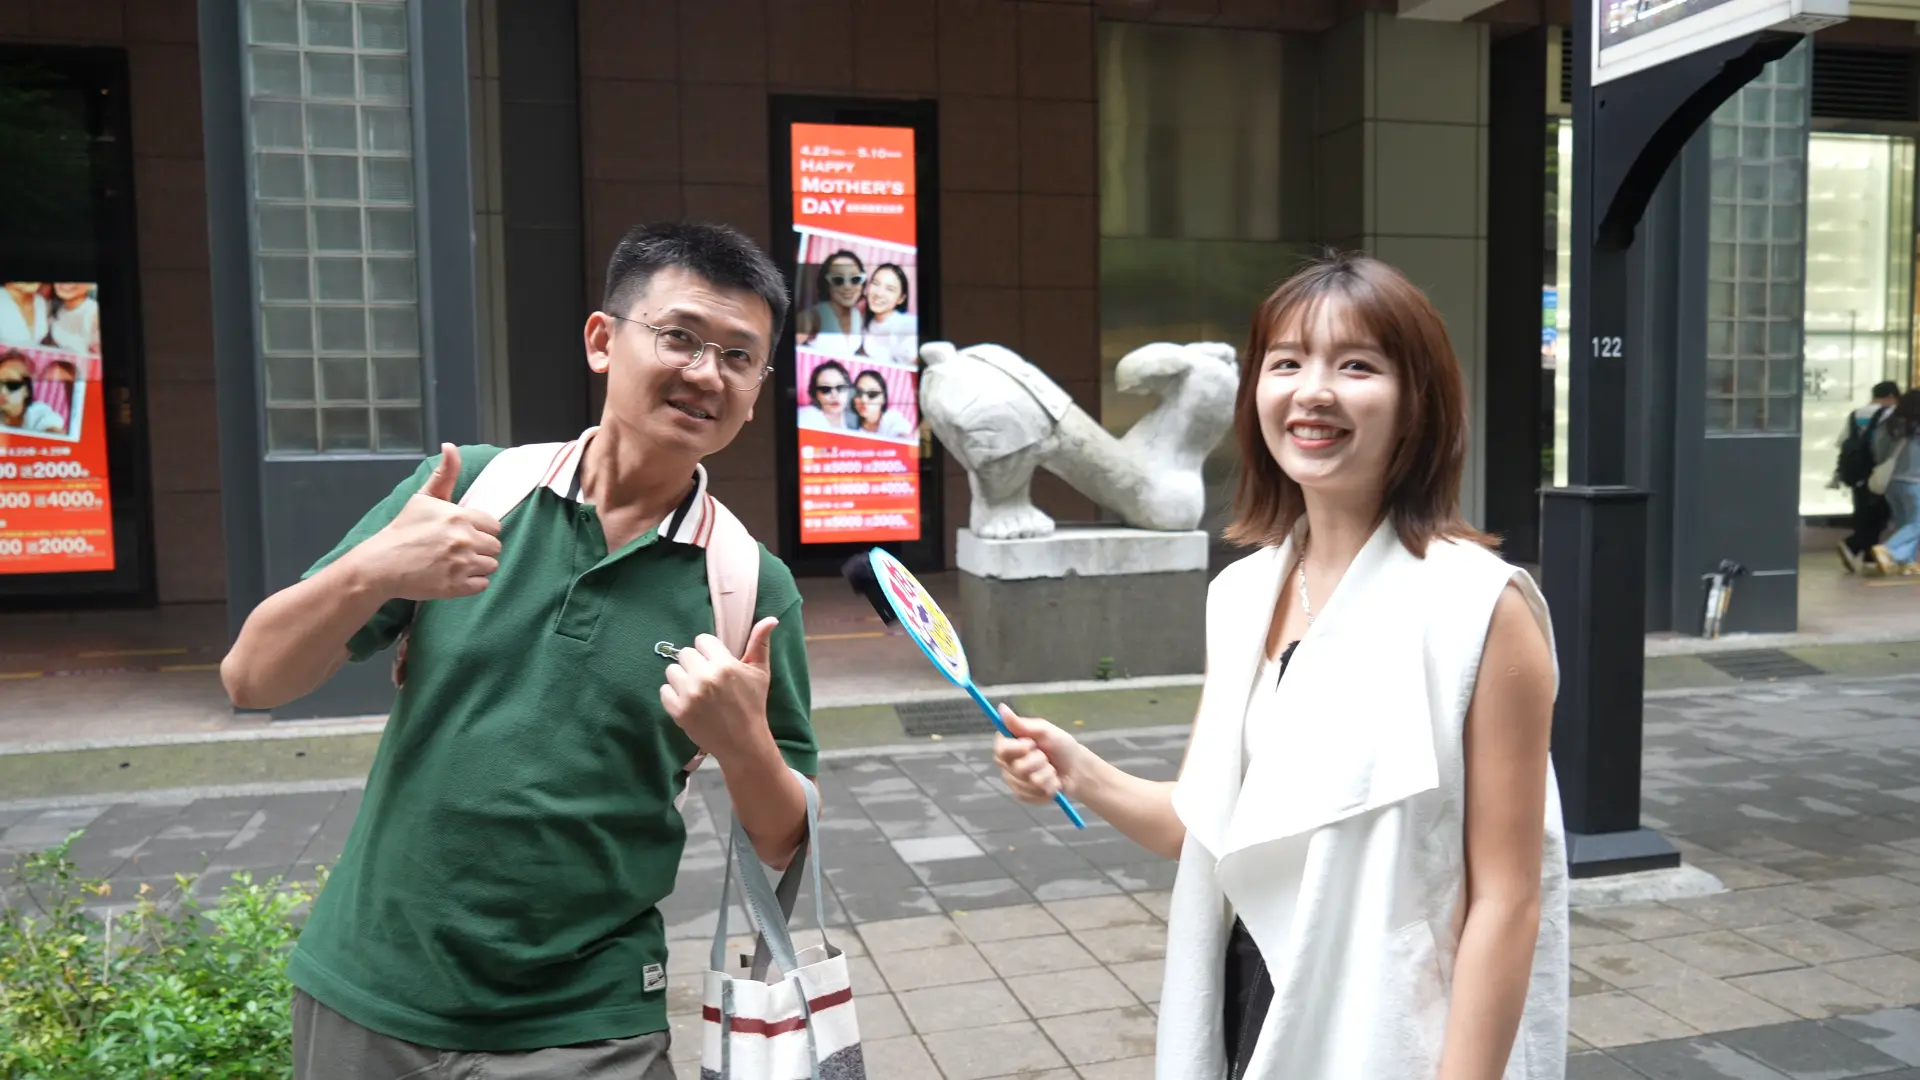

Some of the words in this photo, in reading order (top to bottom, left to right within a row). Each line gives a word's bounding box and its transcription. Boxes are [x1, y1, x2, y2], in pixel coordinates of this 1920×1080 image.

[800, 158, 855, 173] HAPPY
[801, 176, 904, 196] MOTHER'S
[801, 197, 845, 214] DAY
[1592, 336, 1622, 358] 122
